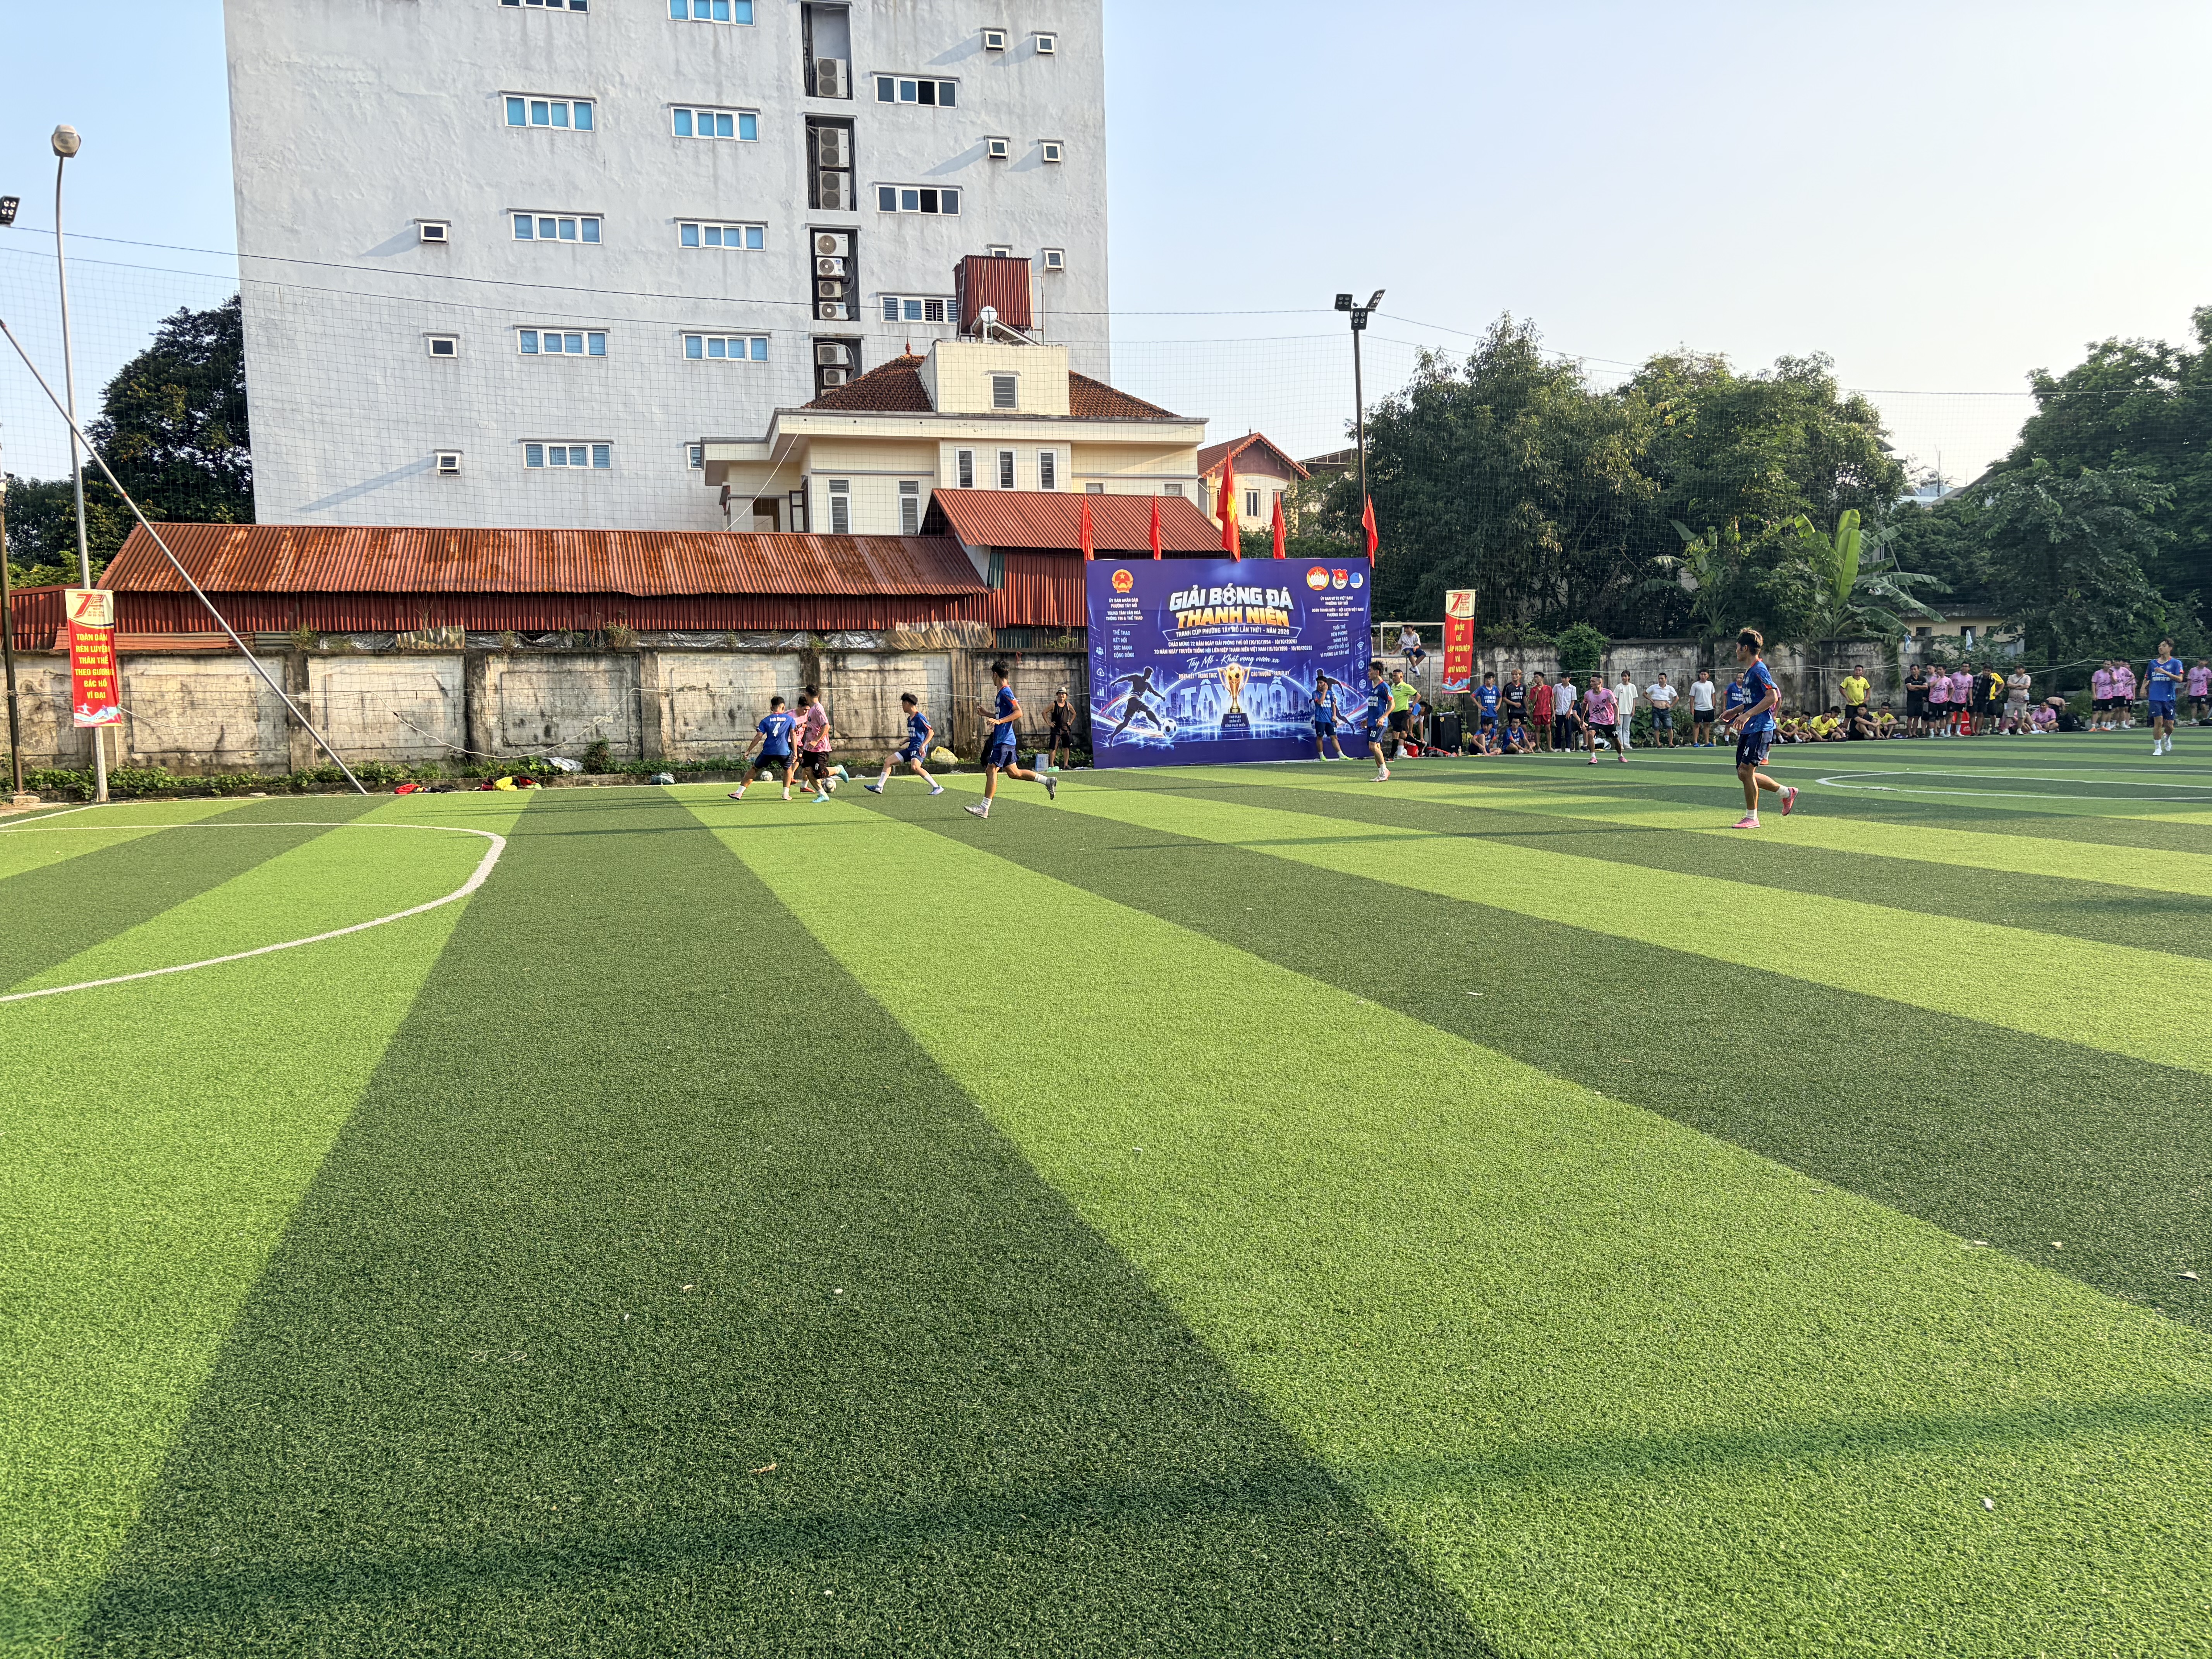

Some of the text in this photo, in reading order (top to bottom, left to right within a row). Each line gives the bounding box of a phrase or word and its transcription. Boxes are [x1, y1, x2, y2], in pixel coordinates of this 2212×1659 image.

[1169, 582, 1294, 611] GIẢI BÓNG ĐÁ
[73, 594, 105, 618] 72
[1176, 606, 1290, 629] THANH NIÊN
[1202, 627, 1221, 635] PHƯỜNG
[1454, 622, 1465, 631] KHỎE
[76, 633, 108, 641] TOÀN DÂN
[1456, 632, 1462, 642] ĐỂ
[90, 645, 110, 653] LUYỆN
[1455, 644, 1470, 653] NGHIỆP
[79, 654, 109, 665] THÂN THỂ
[1186, 657, 1200, 672] Tây
[1201, 655, 1214, 668] Mỗ
[1221, 653, 1239, 665] Khát
[1240, 656, 1255, 666] vọng
[92, 668, 114, 676] GƯƠNG
[94, 692, 106, 700] ĐẠI
[1180, 677, 1287, 718] TÂY MỖ
[772, 722, 781, 737] 4
